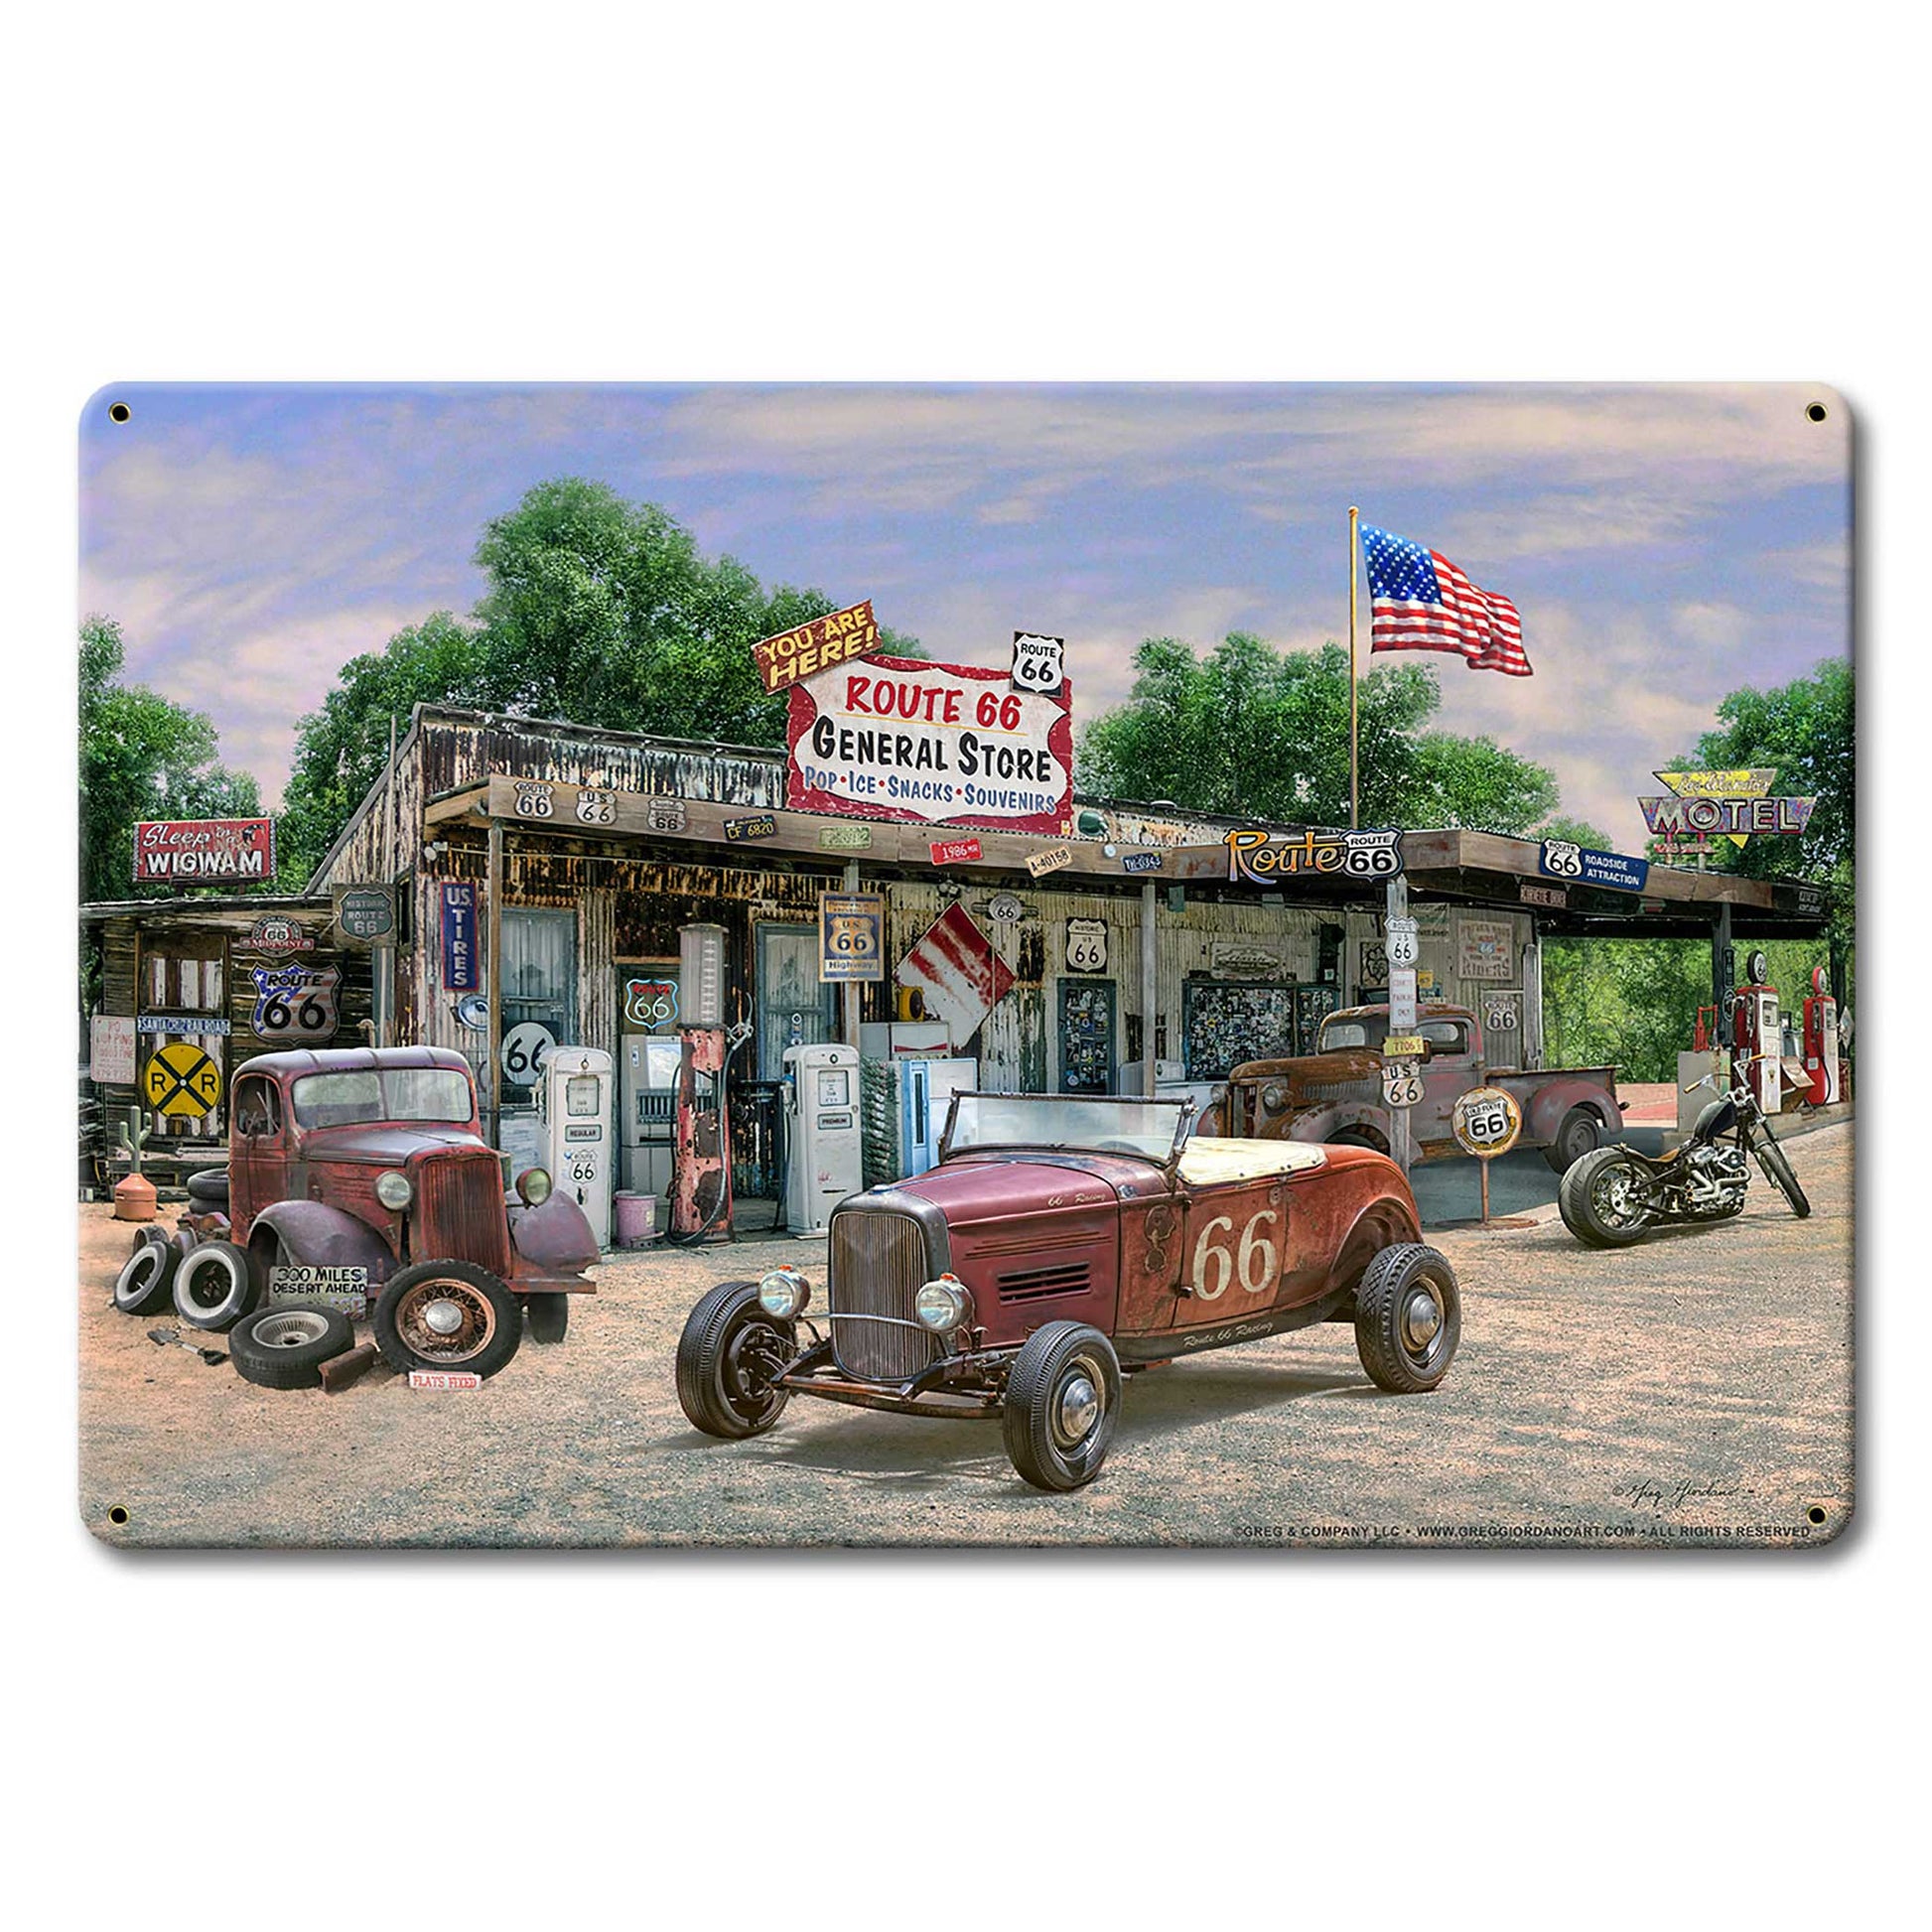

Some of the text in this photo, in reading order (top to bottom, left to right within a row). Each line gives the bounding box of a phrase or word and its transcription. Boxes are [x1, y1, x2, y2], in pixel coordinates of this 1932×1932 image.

[761, 607, 869, 662] YOU ARE
[769, 625, 875, 688] HERE!
[1021, 642, 1056, 658] ROUTE
[1021, 658, 1054, 683] 66
[845, 675, 1023, 731] ROUTE 66
[812, 715, 1052, 782] GENERAL STORE
[518, 782, 550, 793] ROUTE
[519, 794, 548, 816] 66
[583, 804, 611, 822] 66
[656, 817, 677, 830] 66
[1653, 797, 1801, 832] MOTEL
[748, 822, 774, 837] 6820
[1350, 835, 1389, 846] ROUTE
[1549, 841, 1576, 852] ROUTE
[943, 844, 968, 859] 1986
[1222, 827, 1347, 885] Route
[146, 850, 263, 874] WIGWAM
[1349, 849, 1394, 873] 66
[1550, 852, 1578, 875] 66
[1585, 854, 1627, 871] ROADSIDE
[1587, 869, 1640, 886] ATTRACTION
[347, 910, 385, 920] ROUTE
[998, 906, 1014, 918] 66
[267, 930, 286, 940] 66
[353, 920, 377, 934] 66
[452, 908, 469, 986] TIRES
[837, 932, 868, 951] 66
[1394, 942, 1411, 959] 66
[1075, 943, 1099, 963] 66
[267, 974, 325, 987] ROUTE
[263, 993, 326, 1030] 66
[634, 996, 670, 1019] 66
[1490, 1011, 1514, 1029] 66
[151, 1072, 166, 1092] R
[201, 1073, 215, 1092] R
[1390, 1079, 1418, 1102] 66
[1471, 1113, 1503, 1137] 66
[573, 1163, 595, 1180] 66
[1047, 1194, 1063, 1207] 66
[1192, 1209, 1278, 1301] 66
[277, 1267, 362, 1283] 300 MILES
[273, 1283, 367, 1295] DESERT AHEAD
[1217, 1328, 1232, 1341] 66
[412, 1374, 478, 1389] FLATS FIXED
